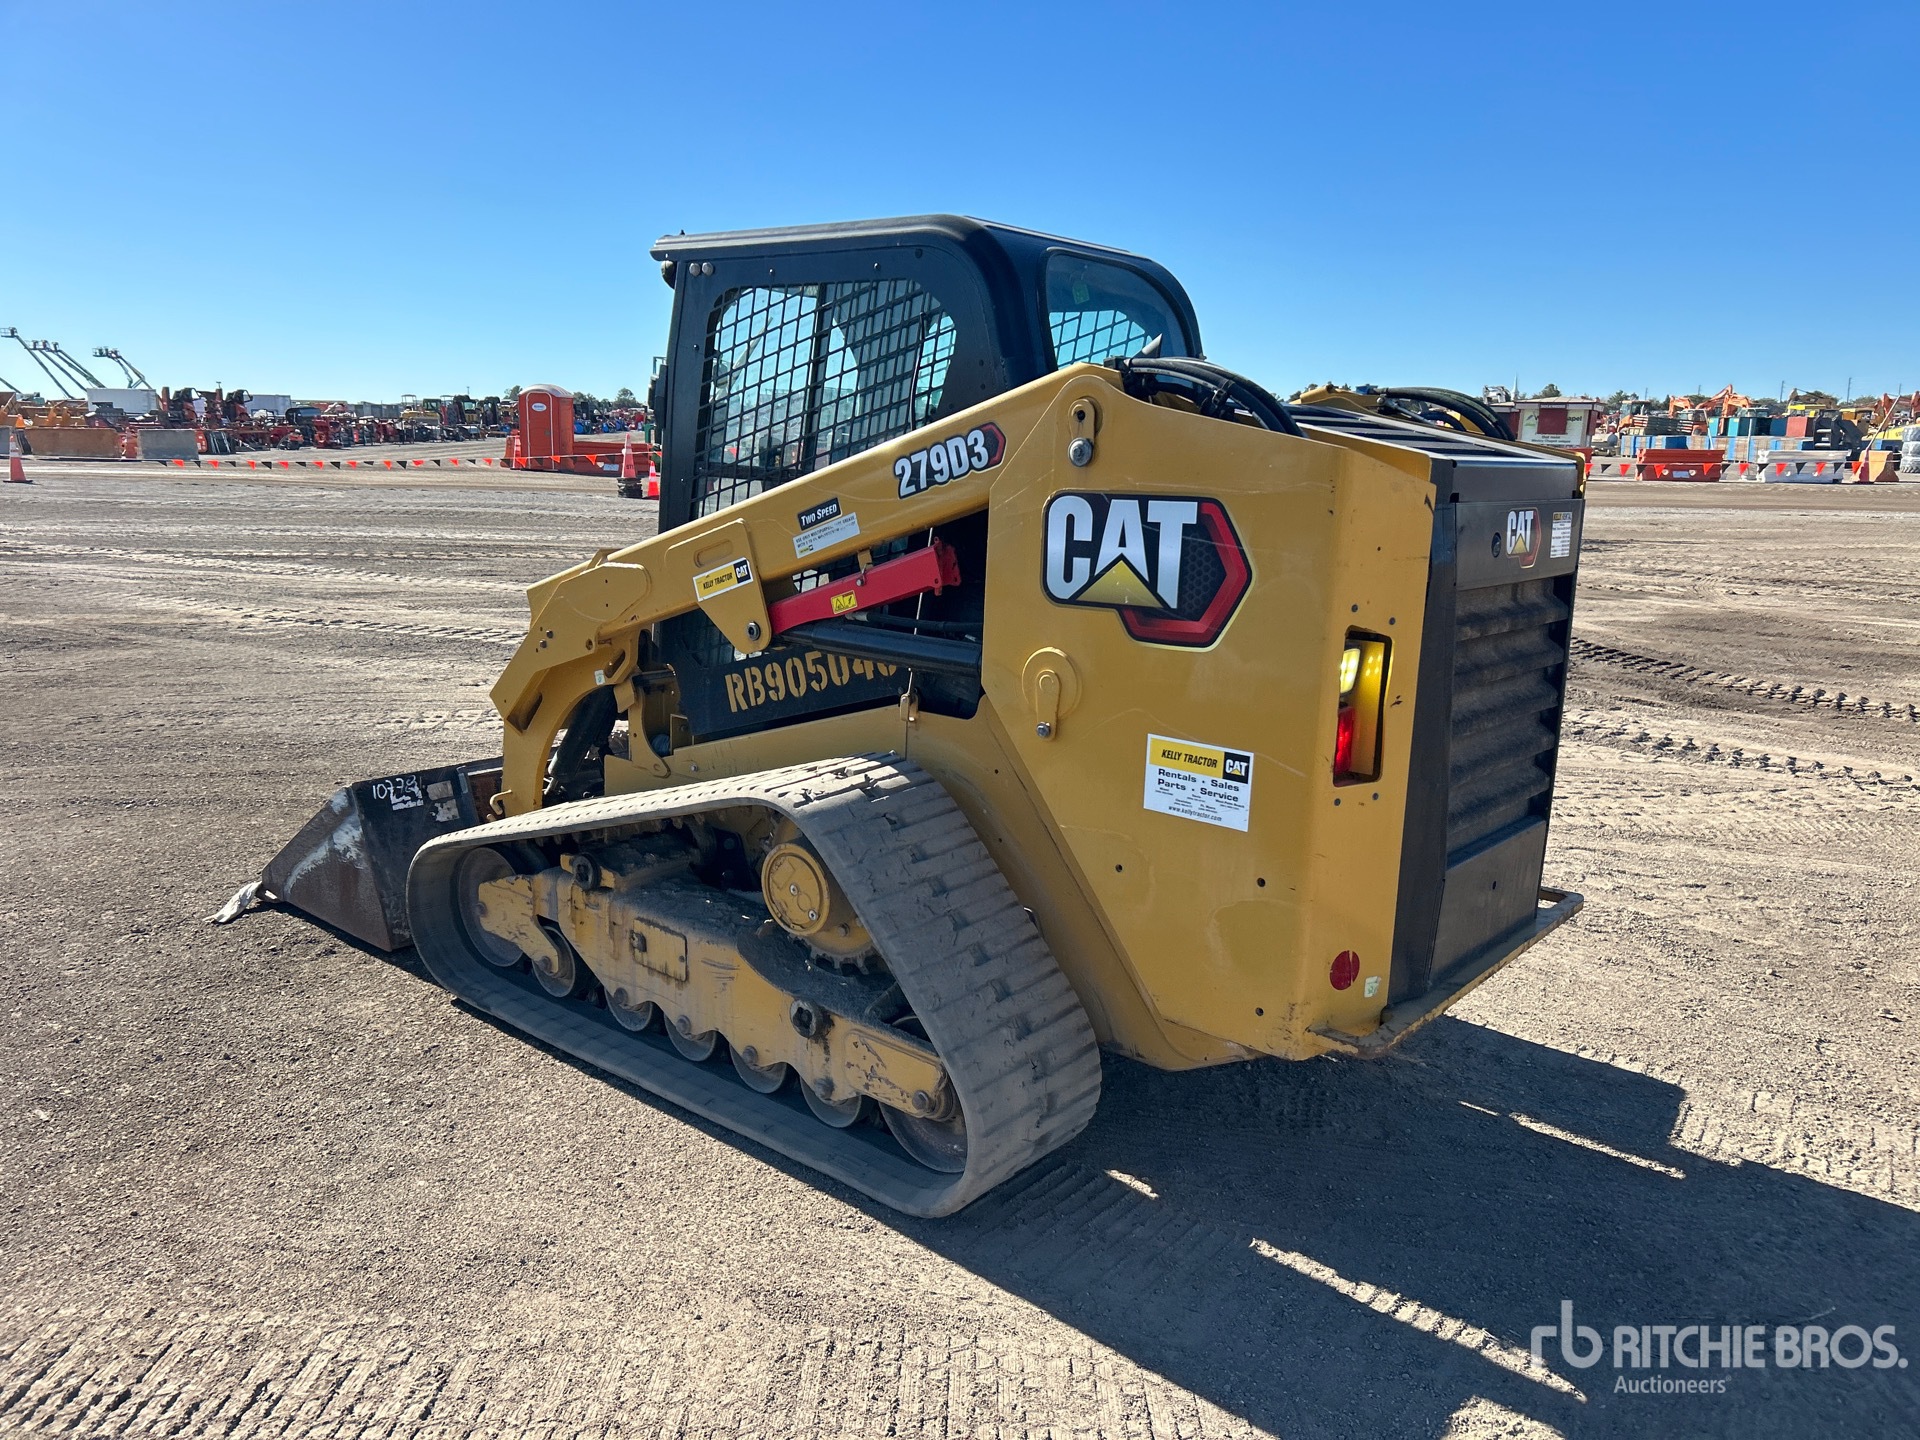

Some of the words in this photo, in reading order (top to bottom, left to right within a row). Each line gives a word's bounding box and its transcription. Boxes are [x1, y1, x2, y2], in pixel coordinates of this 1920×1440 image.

[895, 429, 989, 496] 279D3
[801, 513, 816, 526] TWO
[816, 504, 837, 520] SPEED
[1507, 510, 1534, 554] CAT
[1046, 494, 1198, 609] CAT
[703, 579, 714, 590] KELLY
[714, 573, 733, 585] TRACTOR
[736, 565, 748, 578] CAT
[1161, 749, 1182, 761] KELLY
[1183, 754, 1218, 768] TRACTOR
[1225, 758, 1248, 776] CAT
[1158, 768, 1197, 782] Rentals
[1211, 779, 1240, 791] Sales
[1158, 779, 1186, 790] Parts
[1200, 787, 1239, 802] Service
[1168, 806, 1222, 821] www.kellytractor.com
